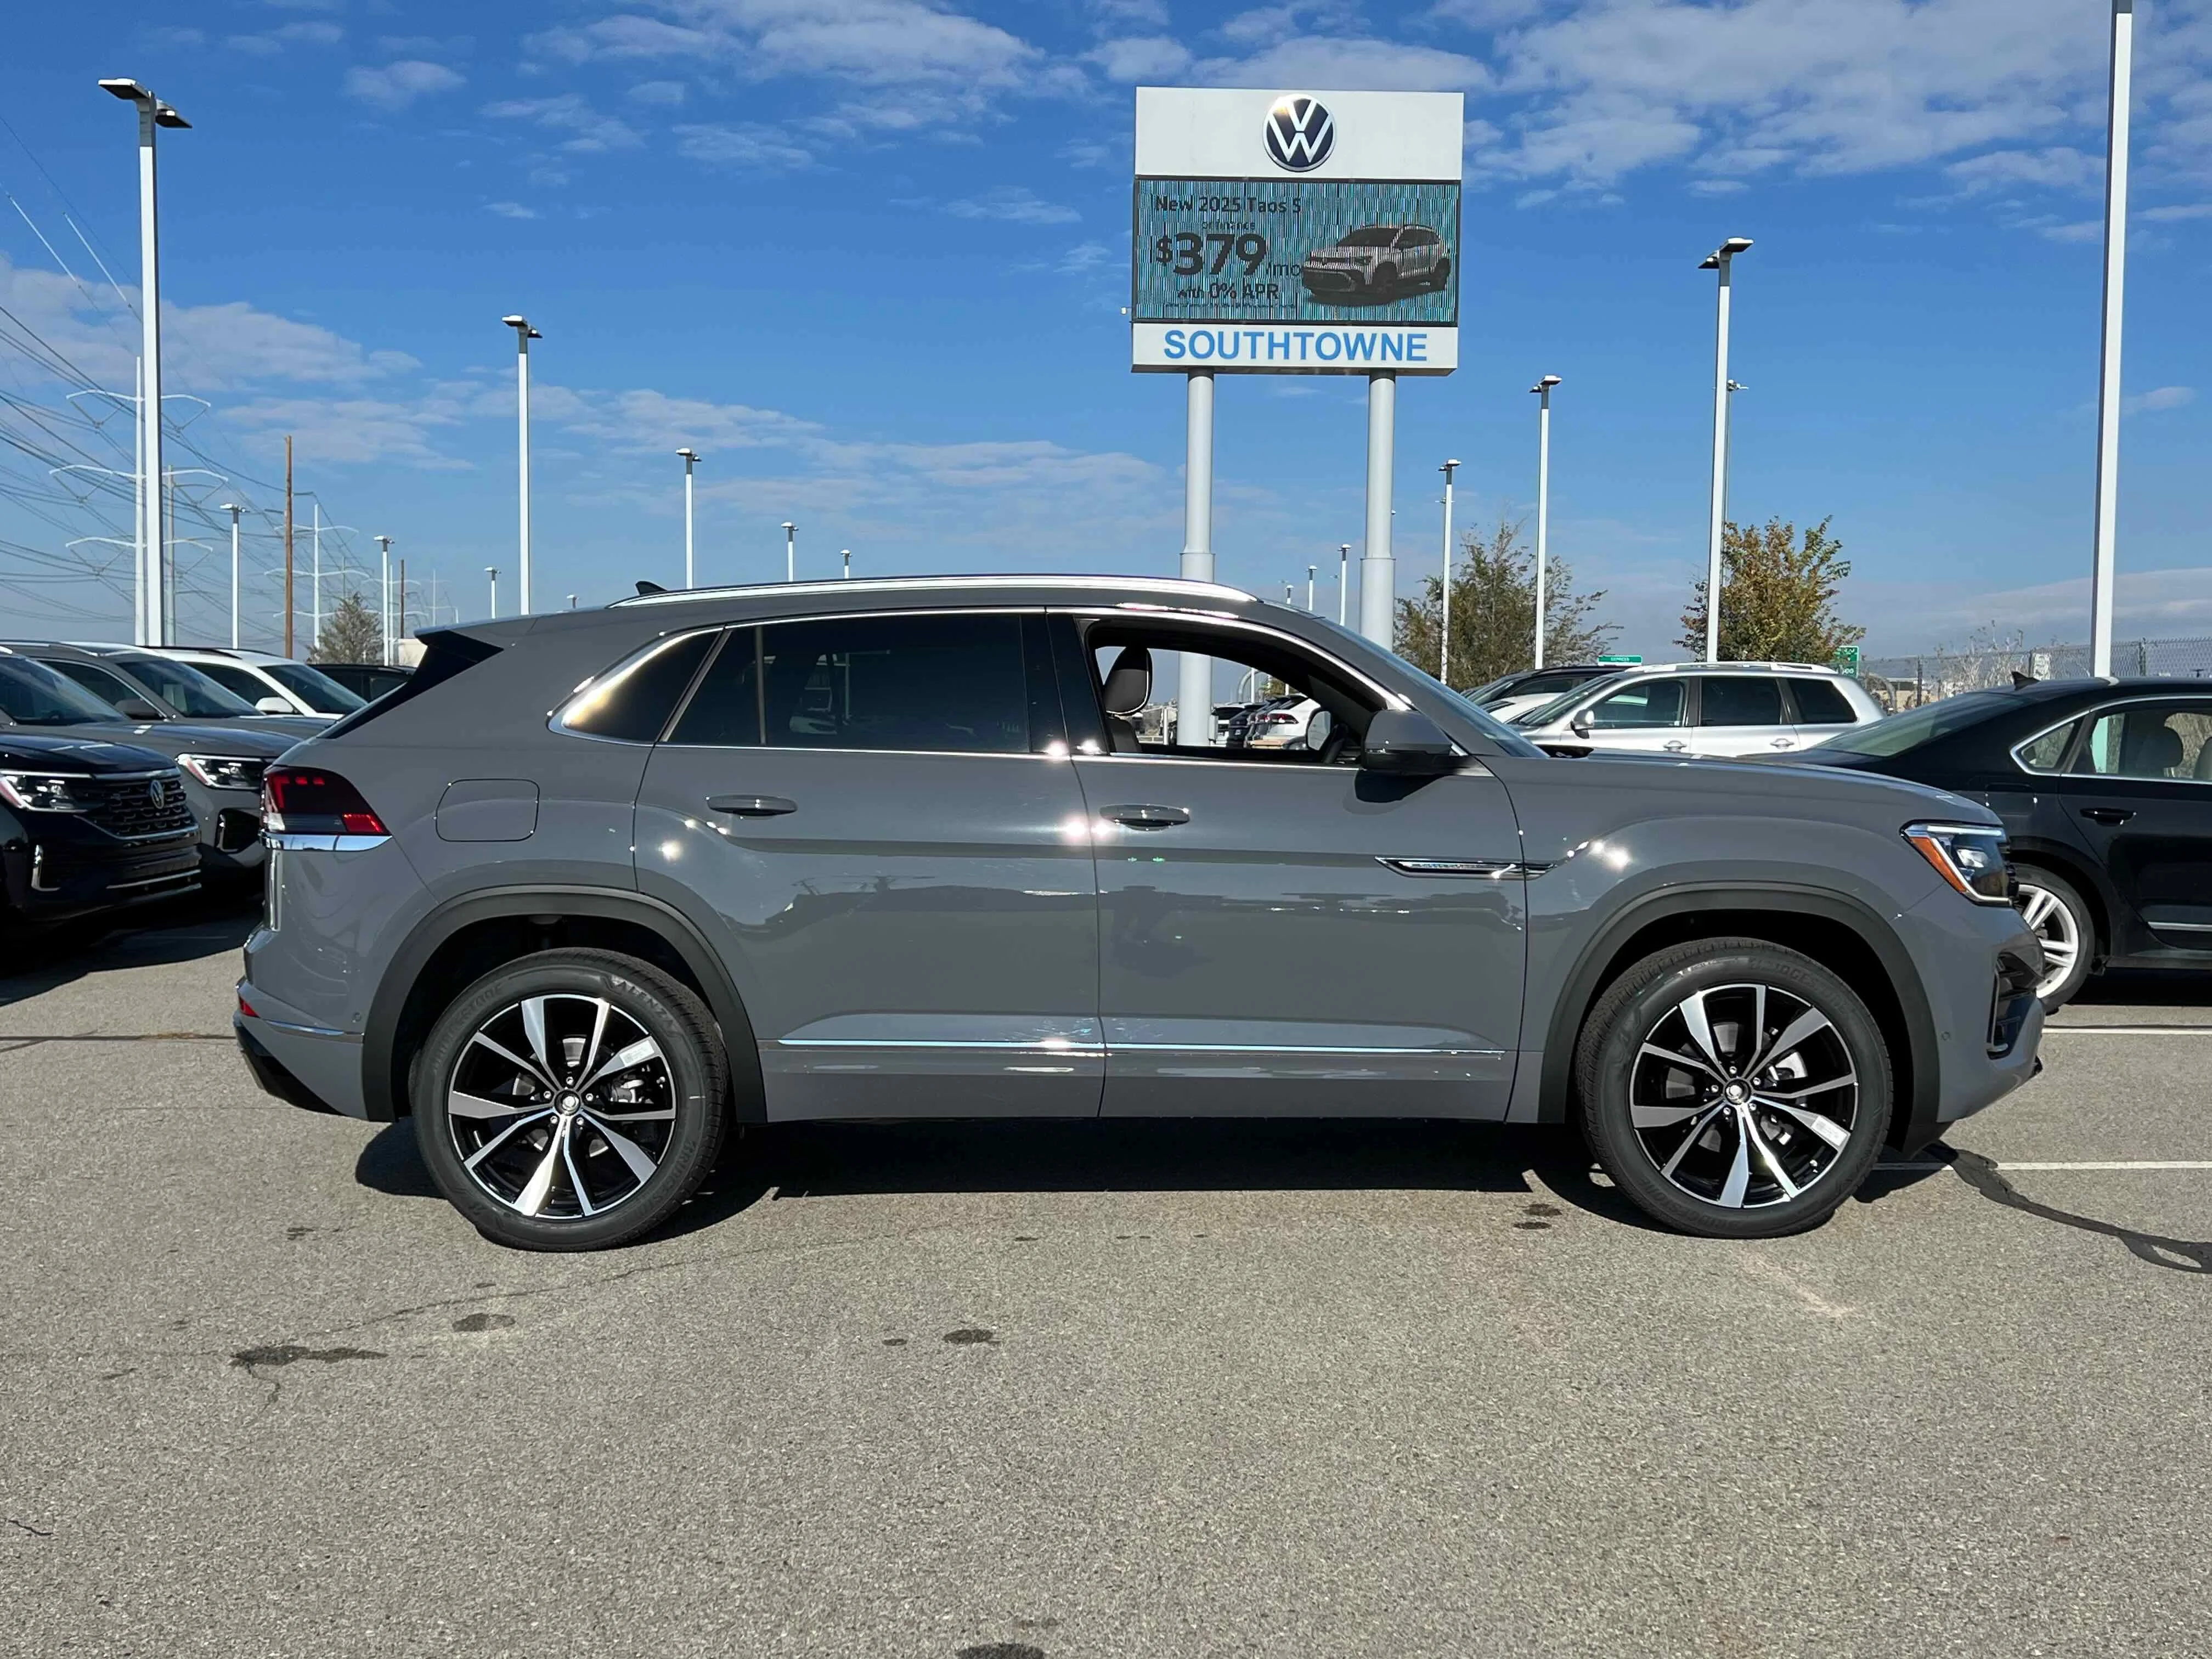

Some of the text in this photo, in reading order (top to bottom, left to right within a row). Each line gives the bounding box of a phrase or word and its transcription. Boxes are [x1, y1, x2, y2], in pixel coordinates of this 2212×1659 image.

[1156, 196, 1193, 212] New
[1198, 196, 1240, 213] 2025
[1247, 196, 1287, 213] Taos
[1156, 232, 1267, 275] $379
[1243, 284, 1279, 300] APR
[1163, 330, 1427, 362] SOUTHTOWNE
